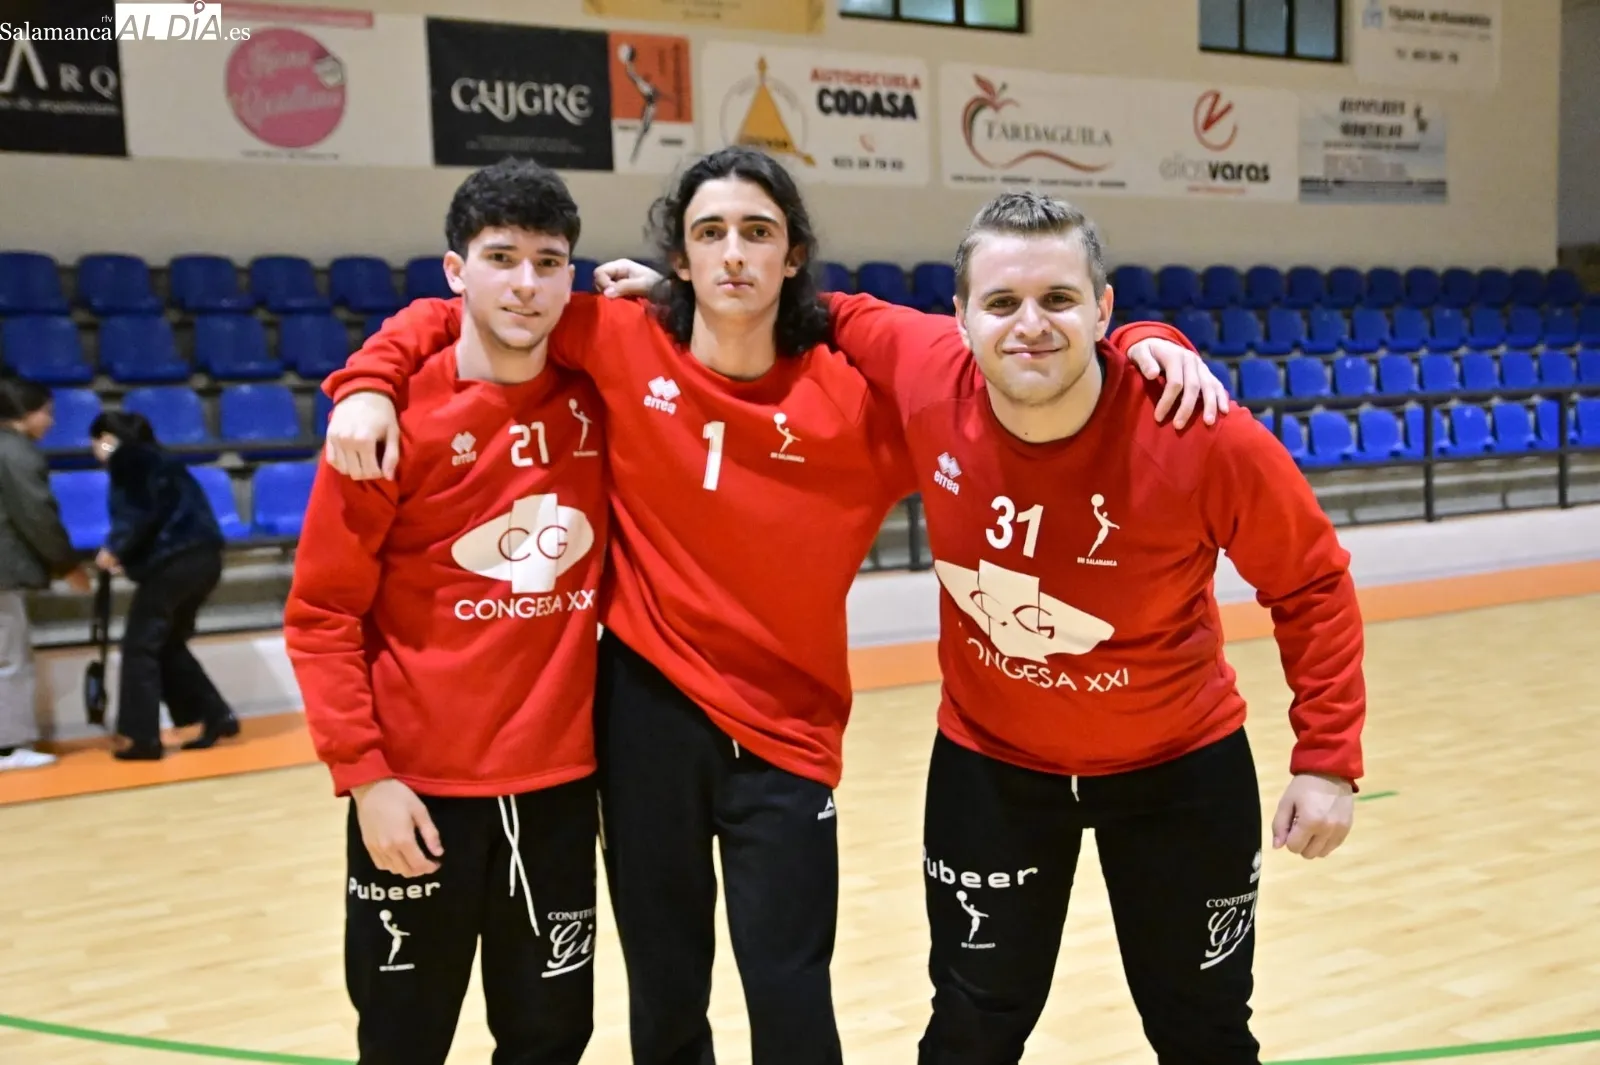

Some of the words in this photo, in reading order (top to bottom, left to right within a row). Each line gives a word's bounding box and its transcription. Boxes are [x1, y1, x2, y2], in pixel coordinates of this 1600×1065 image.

[810, 68, 921, 90] AUTOESCUELA
[817, 88, 918, 120] CODASA
[509, 421, 549, 467] 21
[702, 421, 726, 491] 1
[934, 470, 960, 495] errea
[985, 495, 1044, 558] 31
[454, 595, 563, 621] CONGESA
[966, 636, 1078, 692] ONGESA
[1084, 667, 1130, 693] XXI
[348, 876, 441, 901] Pubeer
